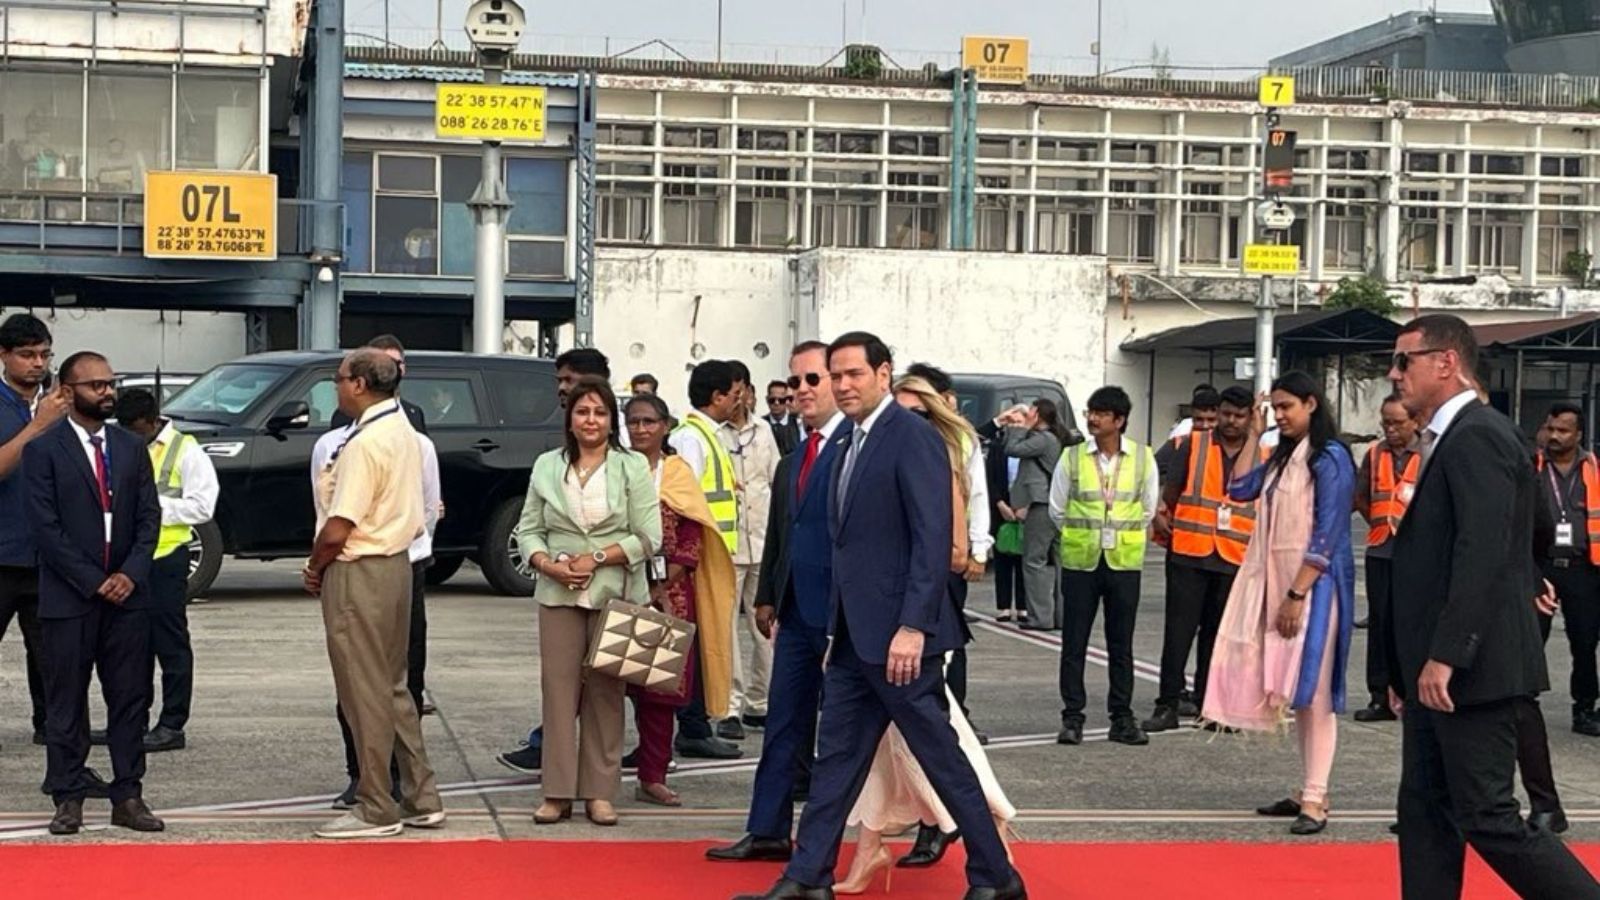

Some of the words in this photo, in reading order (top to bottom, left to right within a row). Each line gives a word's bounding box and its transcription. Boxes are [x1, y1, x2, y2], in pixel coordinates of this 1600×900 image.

[983, 43, 1010, 64] 07
[1271, 82, 1284, 102] 7
[1271, 131, 1286, 147] 07
[182, 184, 241, 222] 07L
